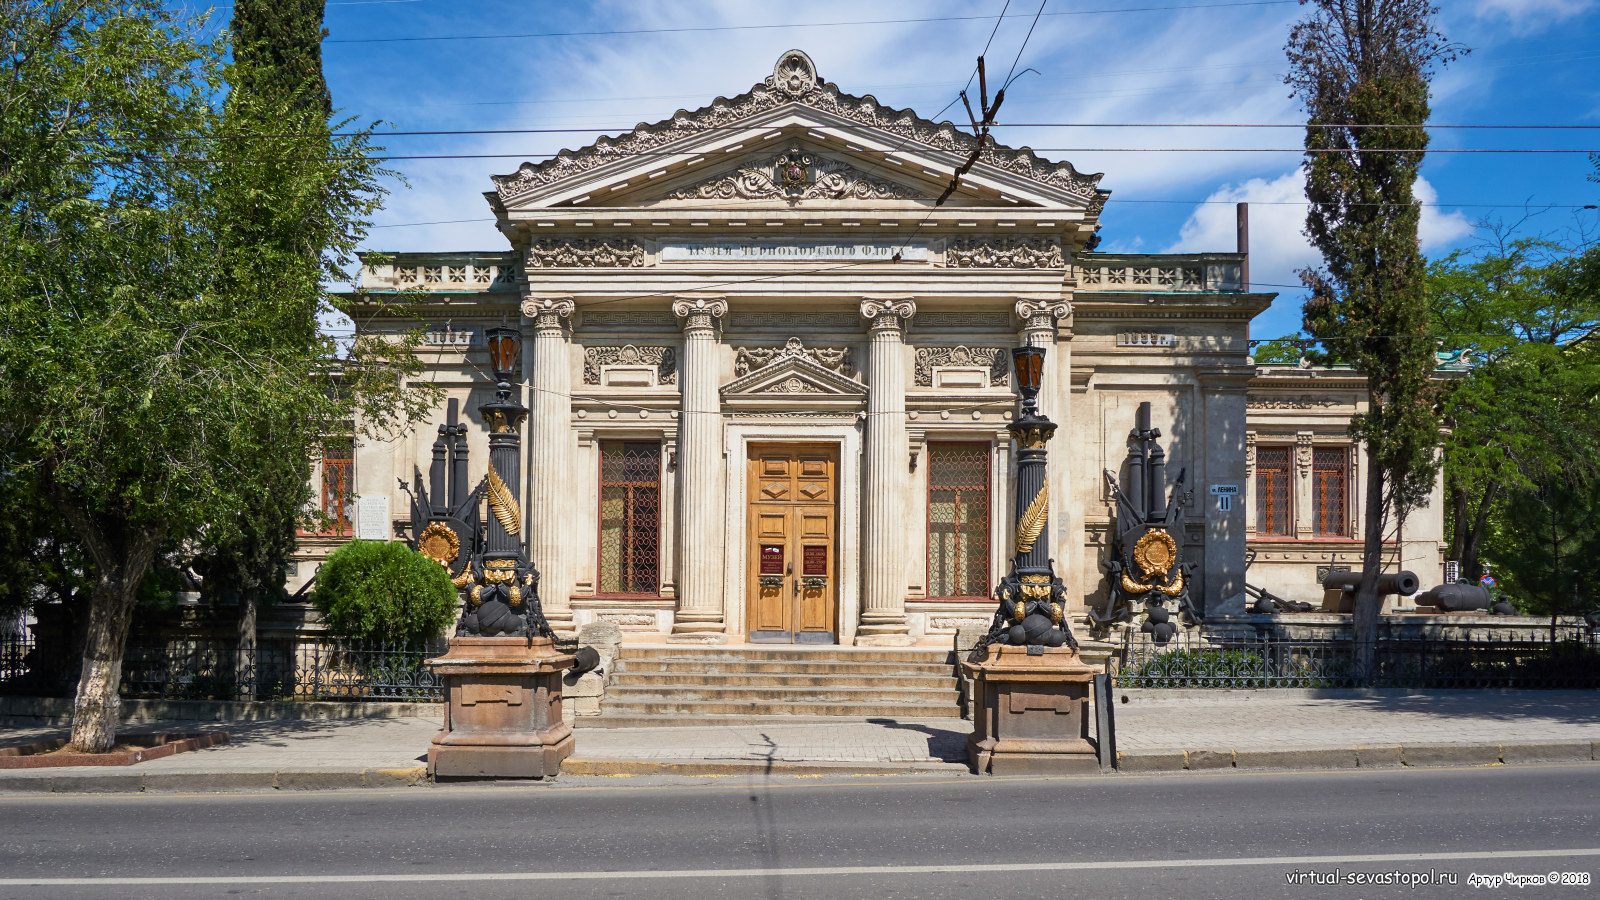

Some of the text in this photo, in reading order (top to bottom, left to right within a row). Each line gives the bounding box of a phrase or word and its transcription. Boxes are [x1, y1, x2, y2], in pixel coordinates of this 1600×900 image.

[689, 245, 904, 256] МУЗЕЙ ЧЕРНОМОРСКОГО ФЛОТА
[1221, 497, 1228, 509] 11
